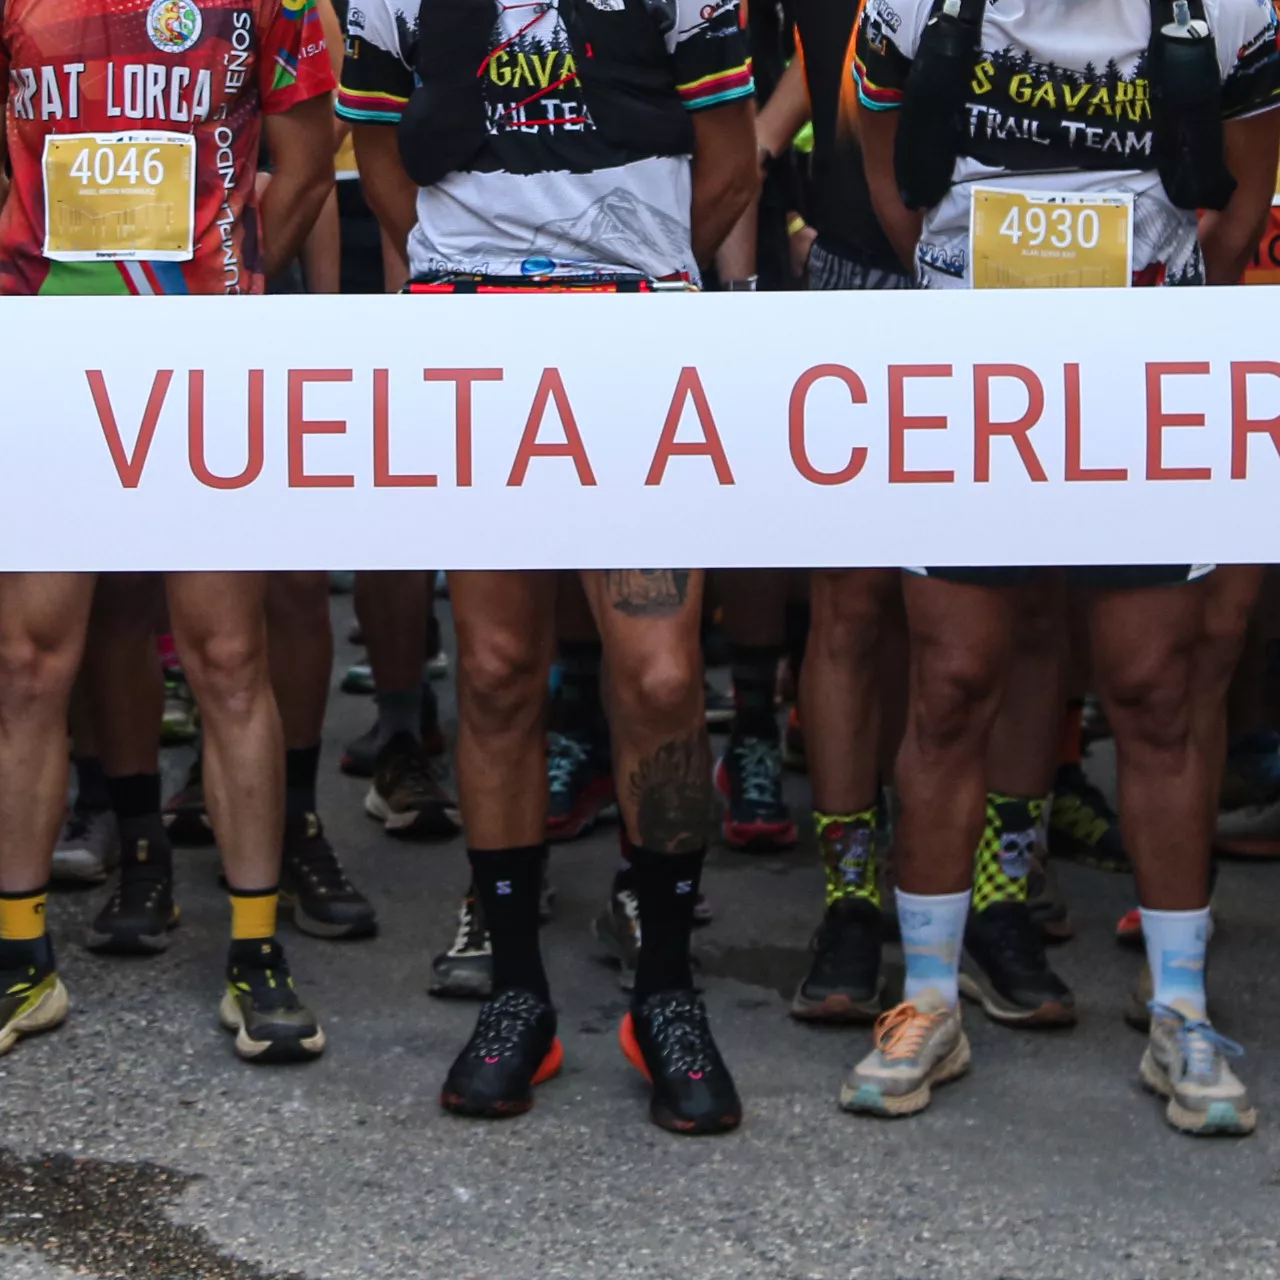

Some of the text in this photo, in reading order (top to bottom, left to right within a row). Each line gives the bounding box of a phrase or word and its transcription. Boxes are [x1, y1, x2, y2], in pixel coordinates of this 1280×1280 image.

[106, 61, 213, 124] LORCA
[965, 102, 1154, 158] TRAIL TEAM
[69, 147, 164, 186] 4046
[999, 206, 1100, 249] 4930
[84, 366, 598, 491] VUELTA
[644, 366, 736, 487] A
